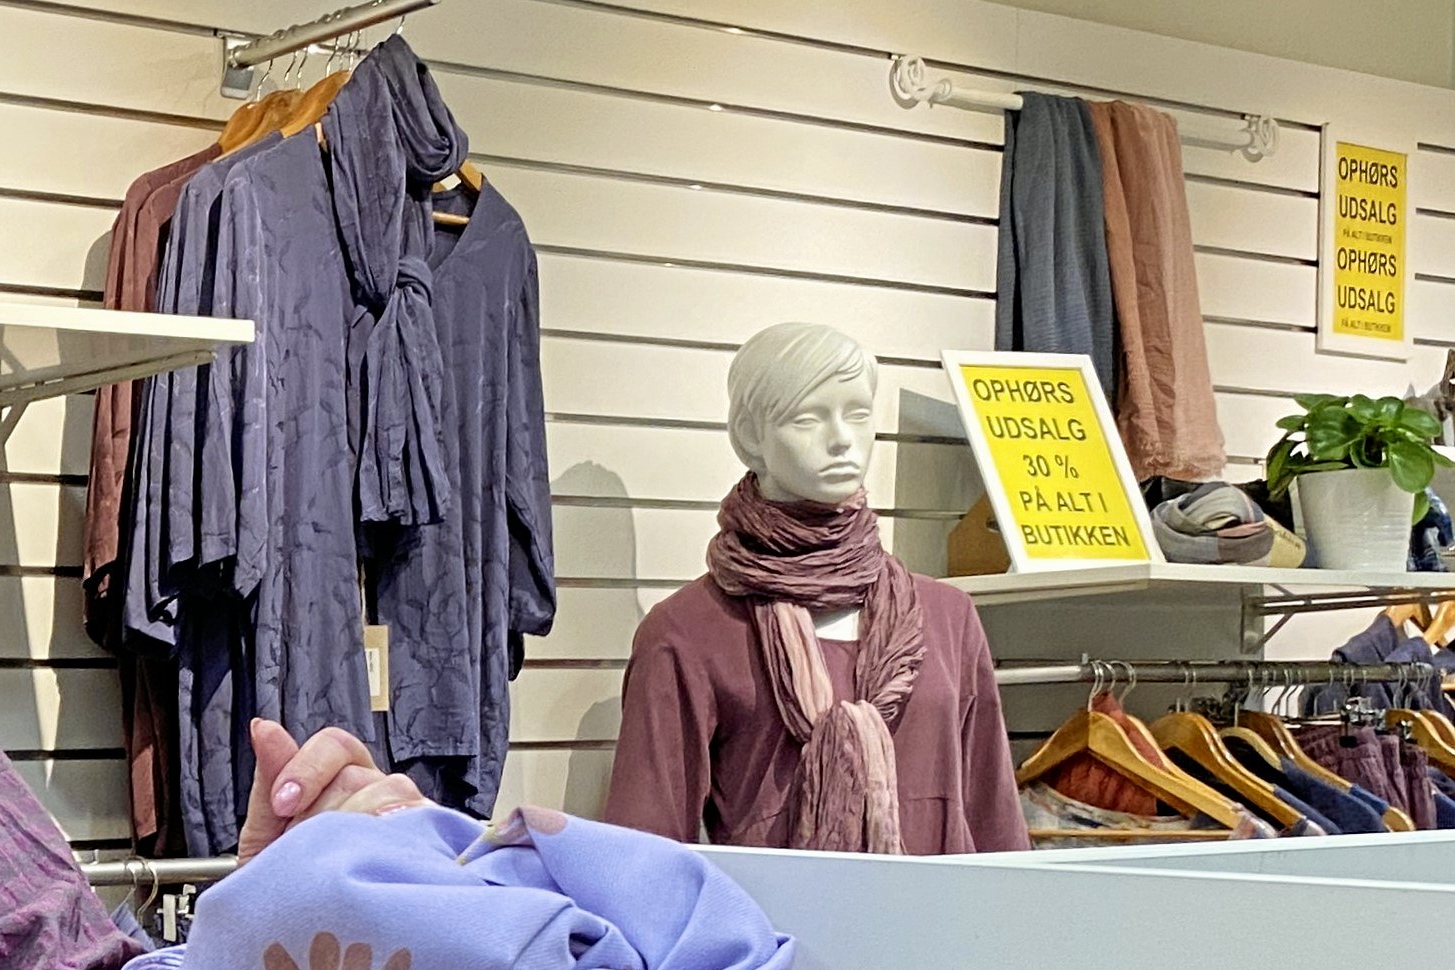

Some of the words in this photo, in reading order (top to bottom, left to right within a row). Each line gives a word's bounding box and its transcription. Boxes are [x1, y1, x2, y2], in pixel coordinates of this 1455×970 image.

[1338, 156, 1398, 189] OPHØRS
[1339, 195, 1397, 226] UDSALG
[1337, 247, 1397, 277] OPHØRS
[1338, 285, 1395, 315] UDSALG
[972, 378, 1074, 404] OPHØRS
[986, 415, 1087, 441] UDSALG
[1022, 454, 1050, 477] 30
[1055, 454, 1079, 479] %
[1019, 485, 1052, 512] PÅ
[1057, 492, 1095, 513] ALT
[1098, 493, 1108, 513] I
[1021, 524, 1131, 546] BUTIKKEN
